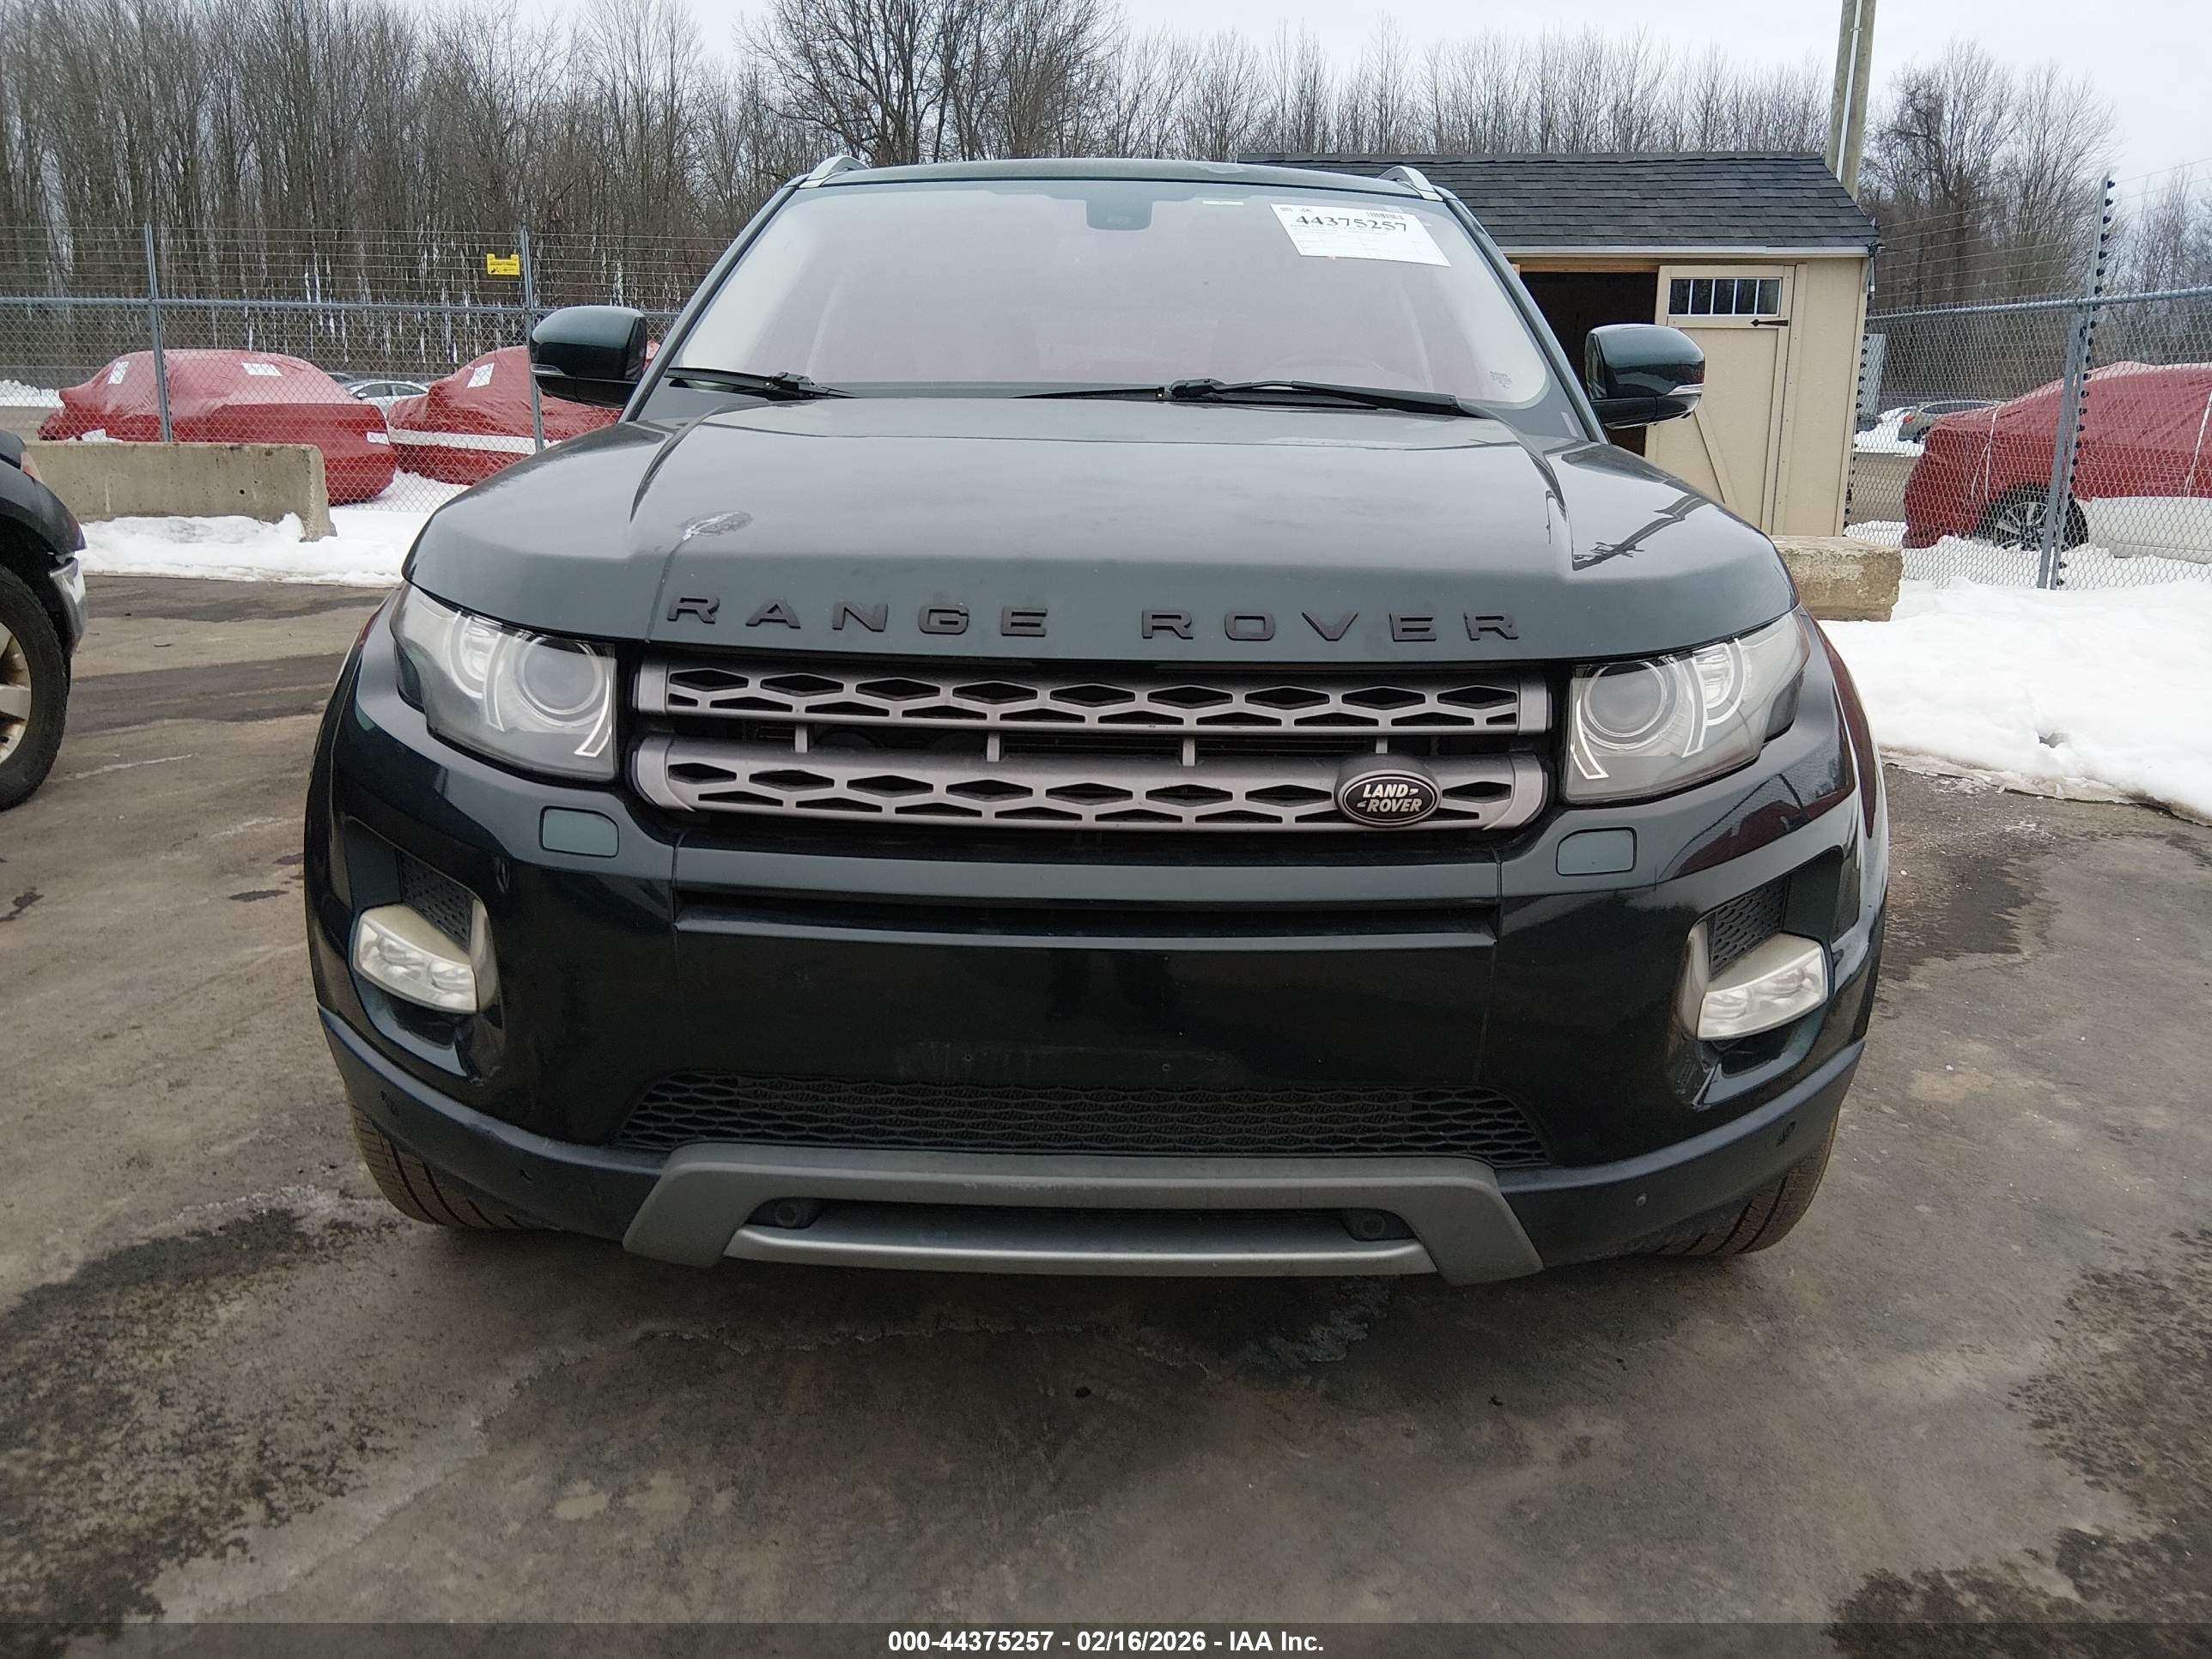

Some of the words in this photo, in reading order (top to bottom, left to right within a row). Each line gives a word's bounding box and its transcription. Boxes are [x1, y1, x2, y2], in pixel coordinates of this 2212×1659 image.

[1296, 216, 1407, 232] 44375257
[667, 597, 1048, 636] RANGE
[1141, 611, 1519, 641] ROVER
[1363, 784, 1408, 798] LAND
[1367, 798, 1423, 812] ROVER
